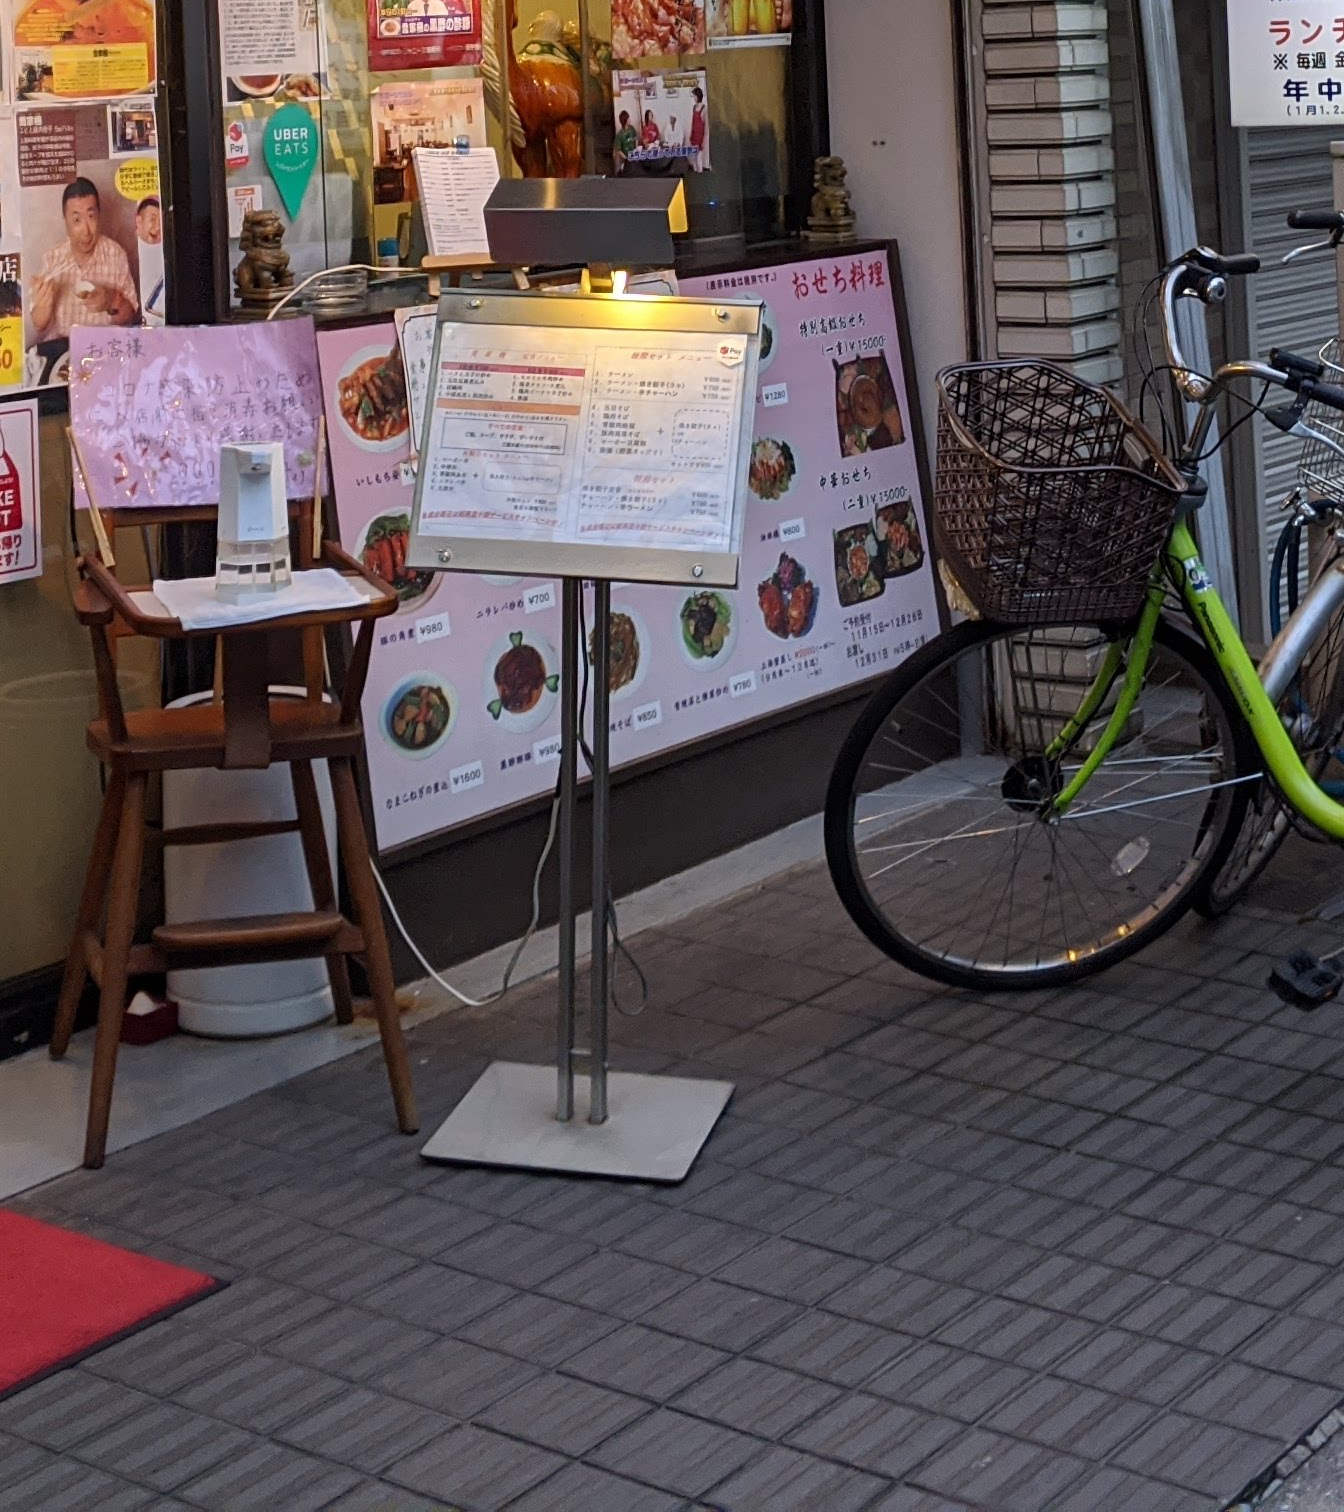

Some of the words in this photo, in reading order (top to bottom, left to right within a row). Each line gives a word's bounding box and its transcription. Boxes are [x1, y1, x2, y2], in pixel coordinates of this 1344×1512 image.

[1297, 51, 1327, 70] 毎週
[273, 128, 308, 141] UBER
[229, 144, 244, 155] Pay
[274, 142, 309, 155] EATS
[791, 259, 886, 300] おせち料理
[528, 591, 550, 605] ¥700
[419, 621, 444, 636] ¥980
